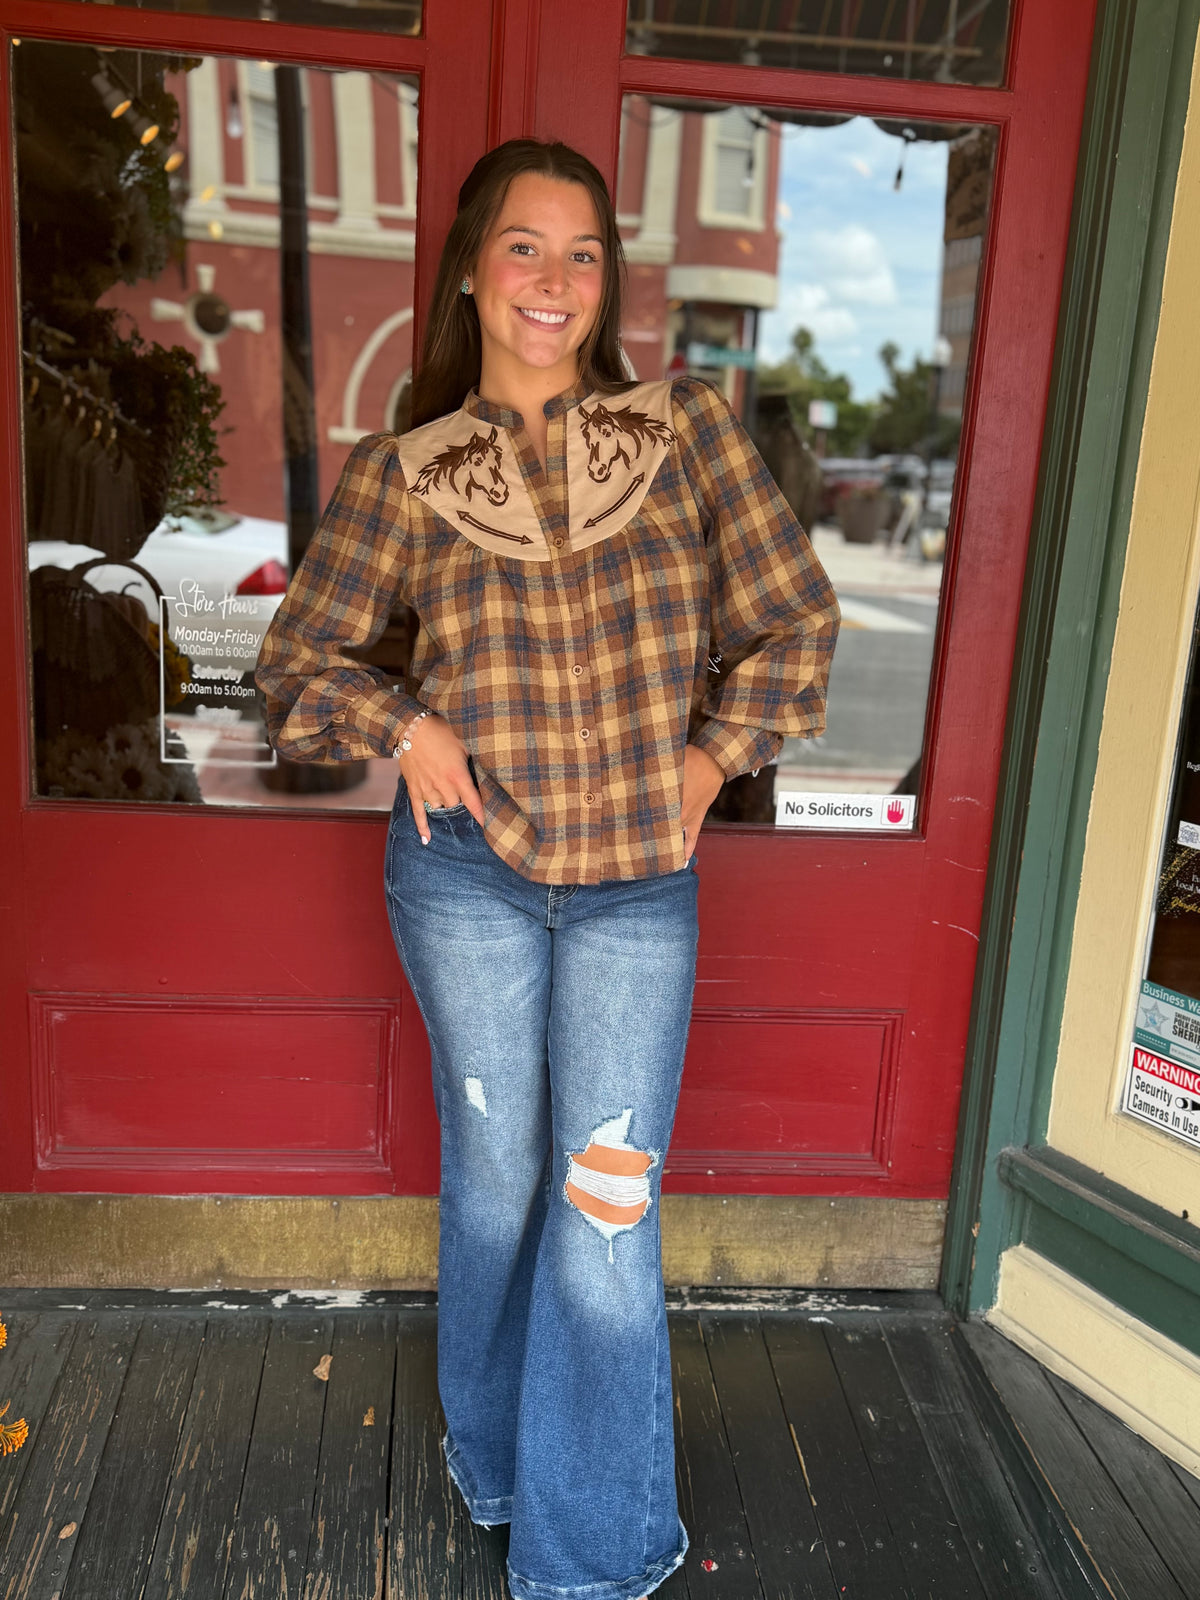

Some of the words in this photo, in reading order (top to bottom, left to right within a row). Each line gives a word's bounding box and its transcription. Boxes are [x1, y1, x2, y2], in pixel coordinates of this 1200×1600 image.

[175, 578, 215, 617] Store
[218, 592, 259, 620] Hours
[175, 626, 261, 647] Monday-Friday
[215, 646, 224, 657] to
[225, 647, 258, 659] 600pm
[192, 664, 245, 684] Saturday
[180, 682, 212, 695] 9:00am
[214, 685, 223, 695] to
[785, 801, 804, 815] No
[808, 802, 873, 817] Solicitors
[1143, 983, 1185, 1007] Business
[1174, 1017, 1189, 1030] POLK
[1135, 1075, 1173, 1107] Security
[1132, 1094, 1169, 1123] Cameras
[1172, 1111, 1180, 1128] In
[1183, 1116, 1199, 1136] Use
